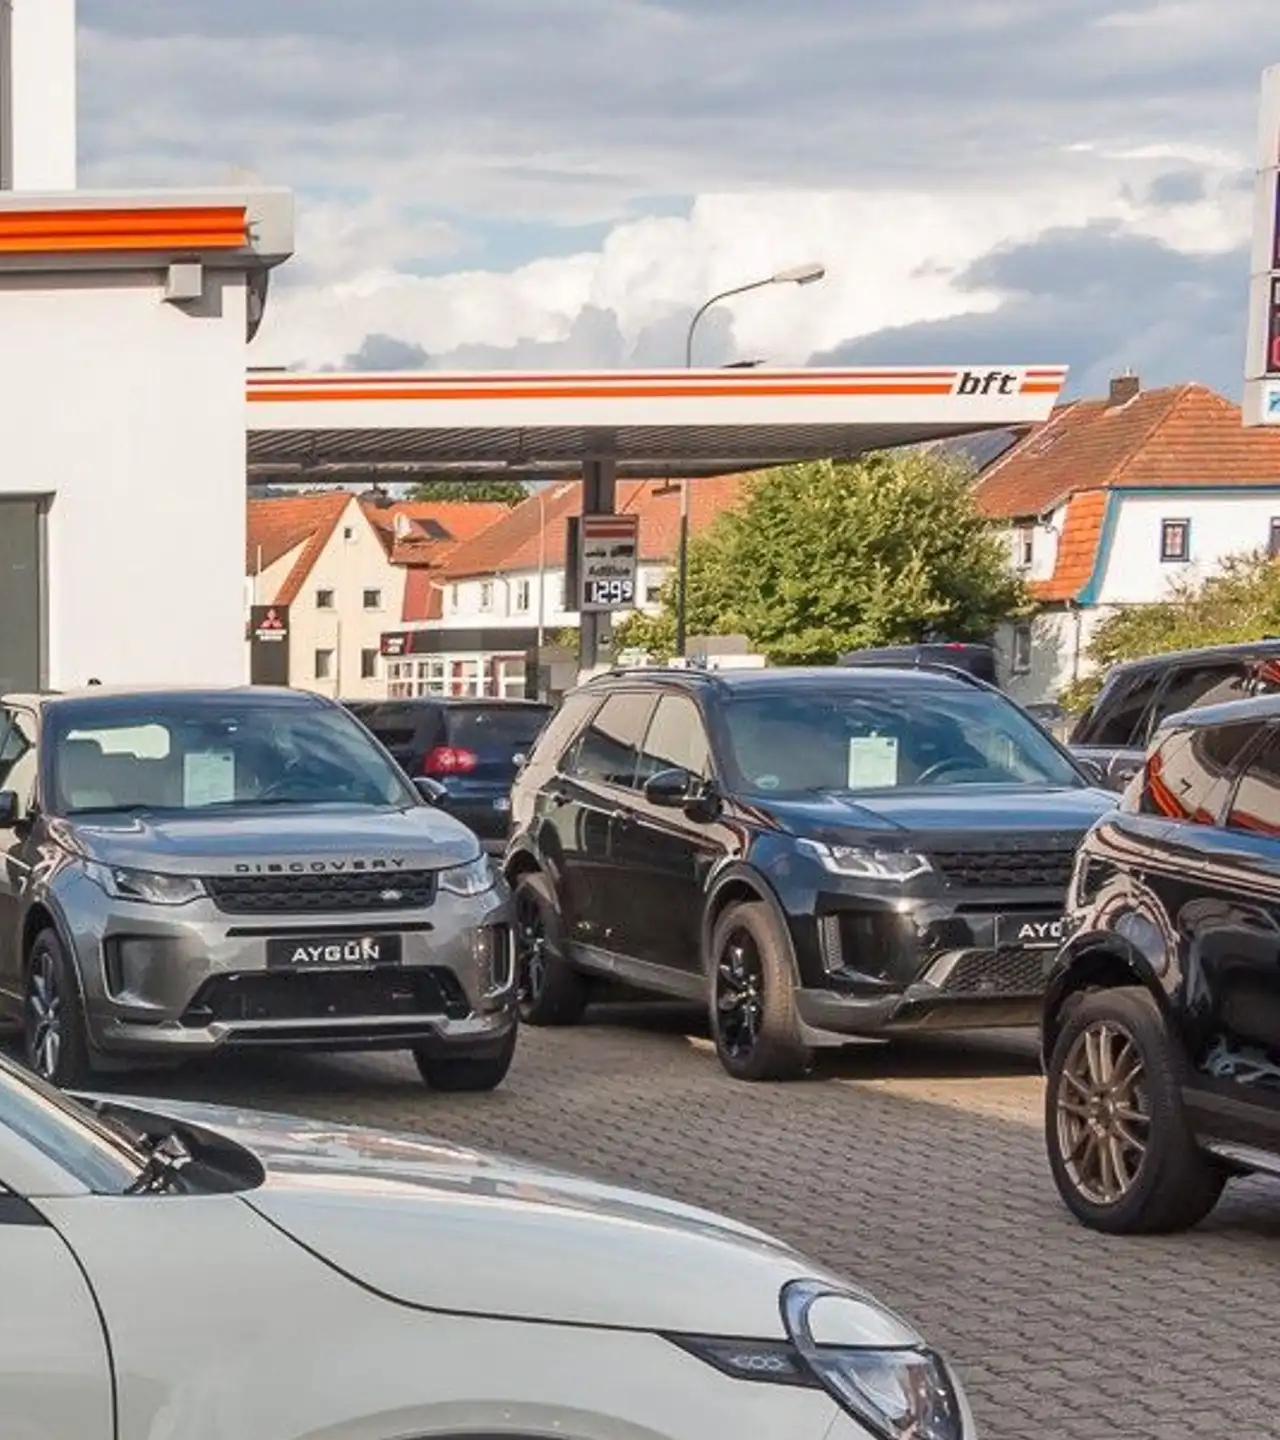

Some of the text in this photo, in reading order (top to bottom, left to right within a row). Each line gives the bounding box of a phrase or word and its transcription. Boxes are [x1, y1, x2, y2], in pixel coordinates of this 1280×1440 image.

[957, 371, 1017, 395] bft
[235, 858, 405, 873] DISCOVERY
[292, 941, 380, 962] AYGÜN
